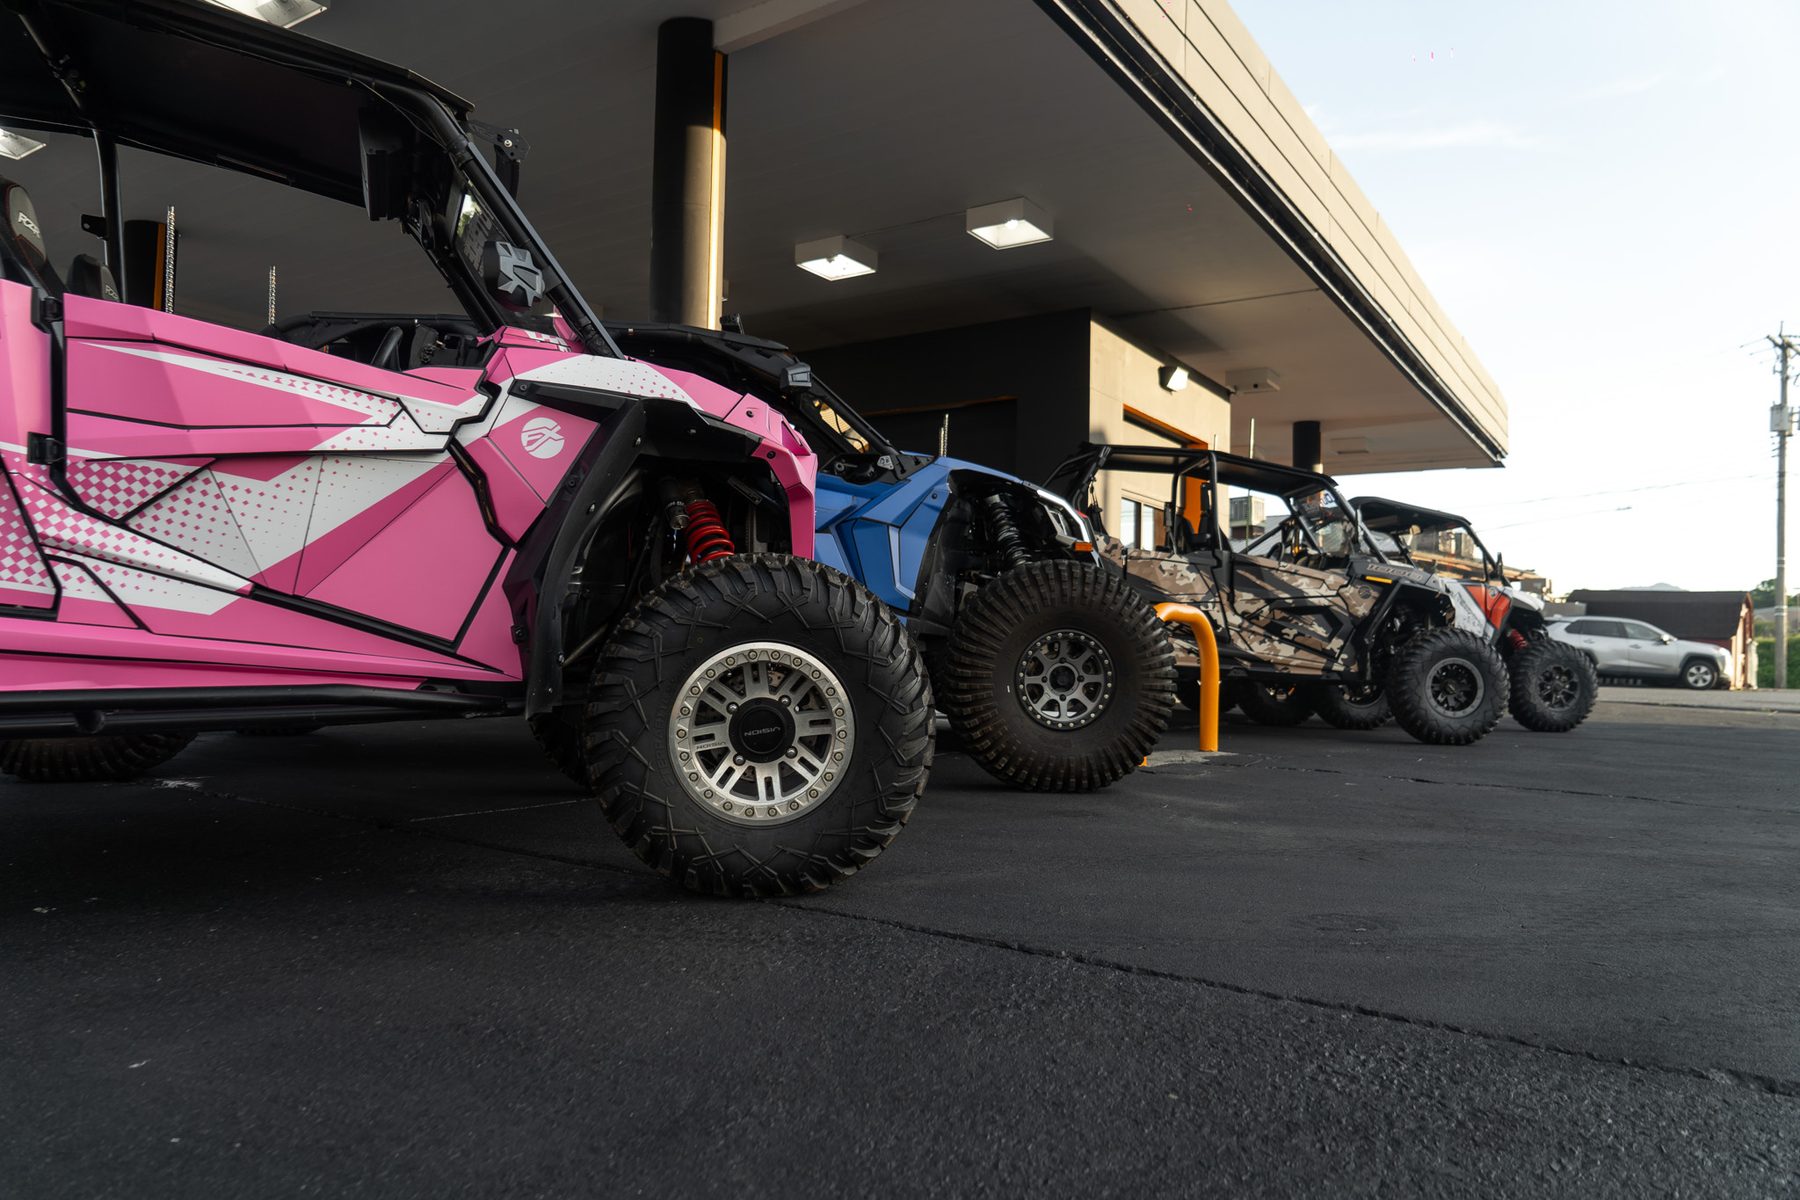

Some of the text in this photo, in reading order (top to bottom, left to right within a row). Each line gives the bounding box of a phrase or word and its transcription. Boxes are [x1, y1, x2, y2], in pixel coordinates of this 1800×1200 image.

[18, 211, 40, 238] RZR
[744, 726, 781, 737] VISION
[696, 741, 726, 750] VISION
